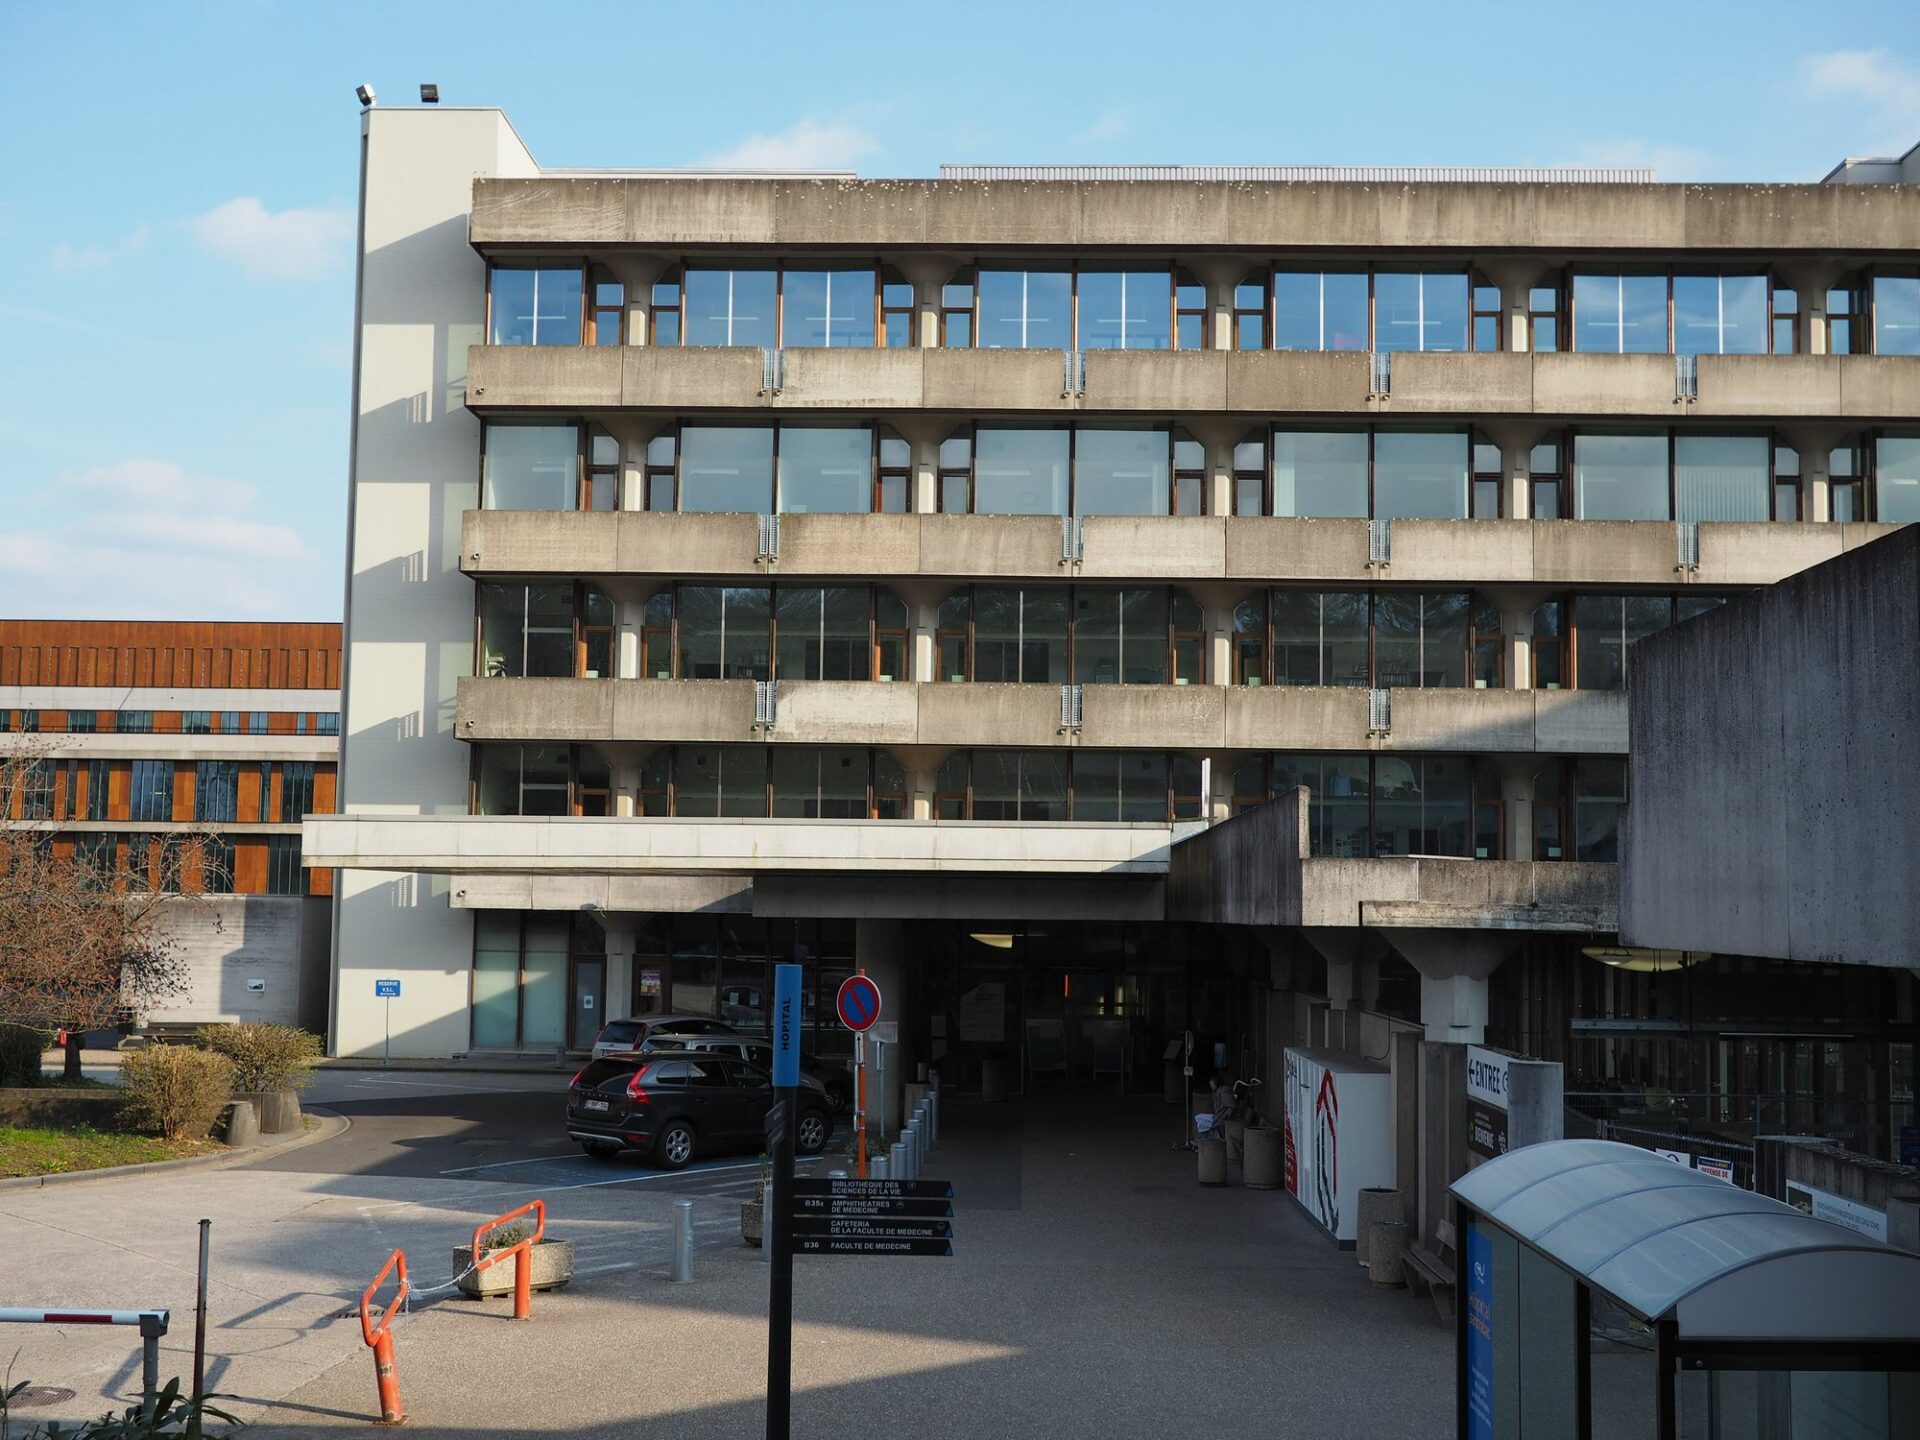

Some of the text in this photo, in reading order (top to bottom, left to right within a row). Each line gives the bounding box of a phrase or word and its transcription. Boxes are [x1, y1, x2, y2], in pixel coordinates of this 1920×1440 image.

[781, 997, 791, 1051] HOPITAL
[1475, 1061, 1500, 1094] ENTREE
[832, 1181, 899, 1189] BIBLIOTHEQUE DES
[831, 1200, 890, 1208] AMPHITHEATRES
[852, 1227, 885, 1235] FACULTE
[897, 1228, 933, 1236] MEDECINE
